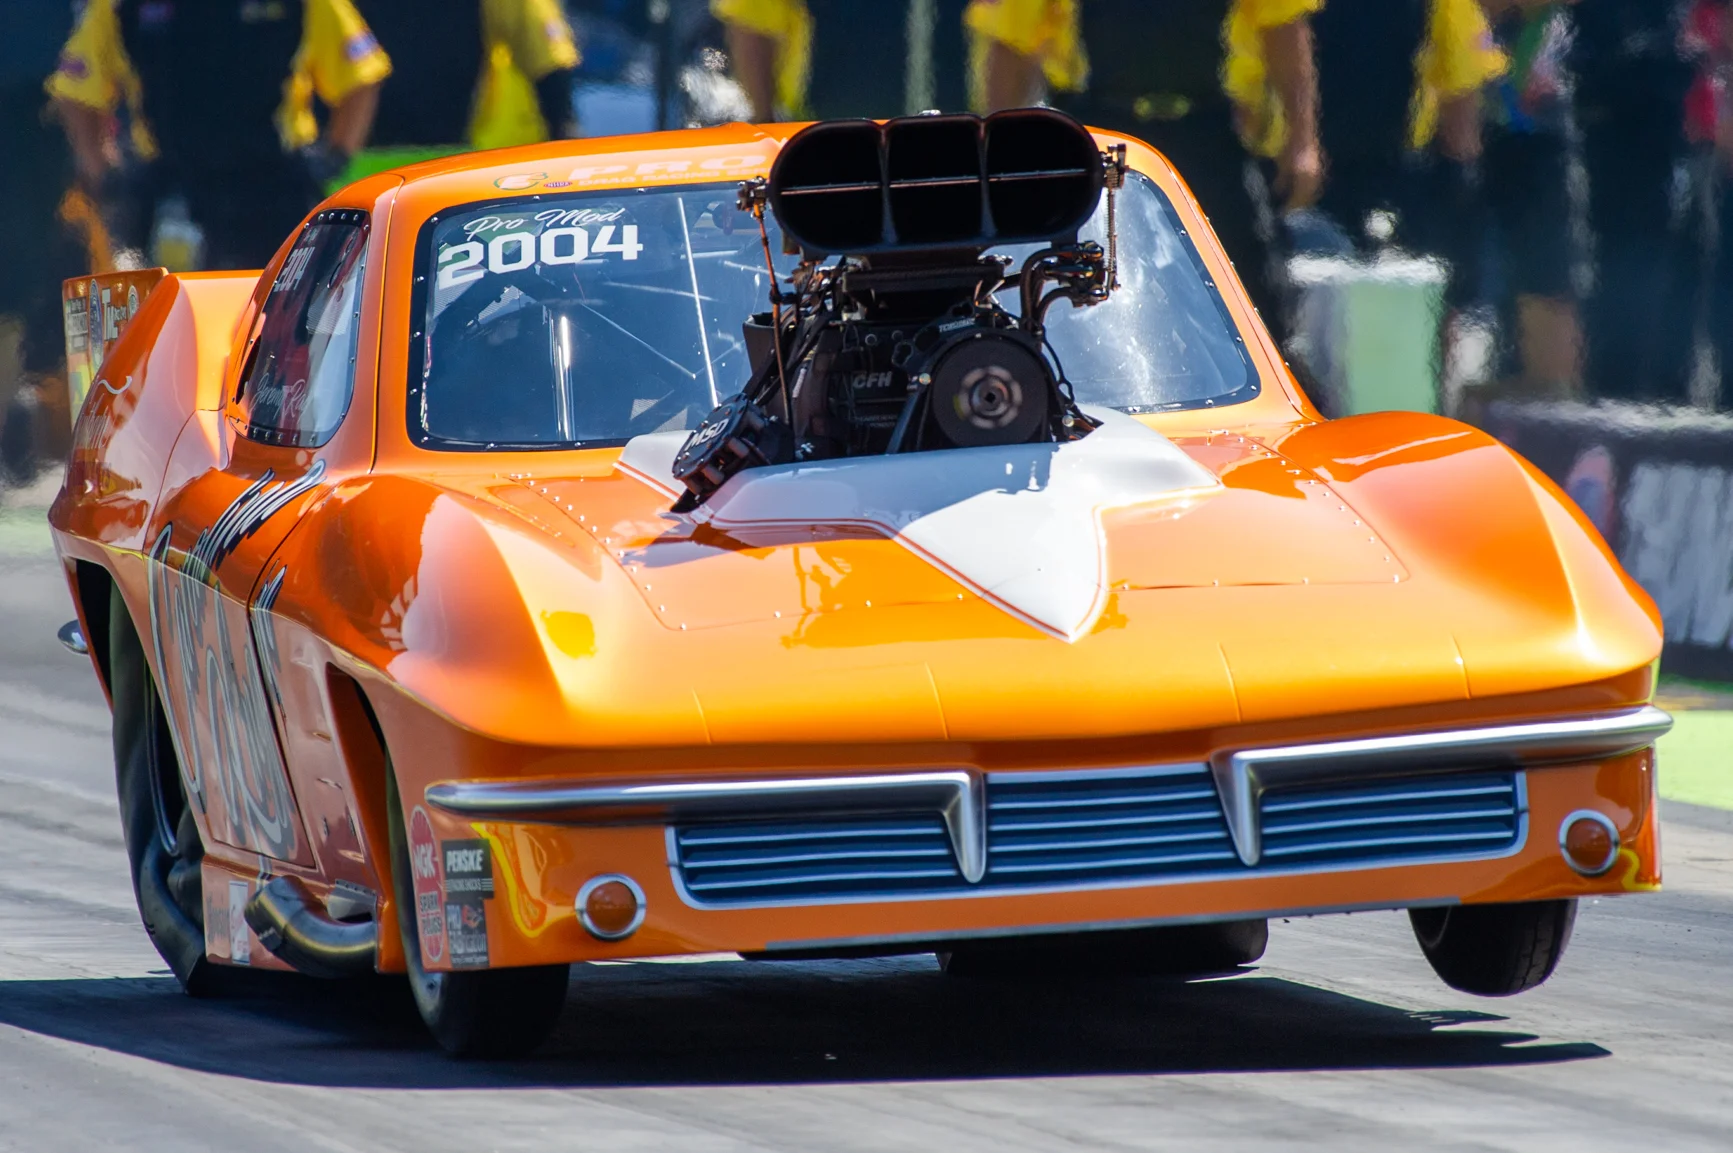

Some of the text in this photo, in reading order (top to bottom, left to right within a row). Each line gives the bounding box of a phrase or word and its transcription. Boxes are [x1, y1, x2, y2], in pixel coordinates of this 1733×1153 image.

[568, 155, 767, 181] PRO
[578, 176, 636, 188] DRAG
[641, 170, 719, 183] RACING
[463, 208, 626, 242] Pro Mod
[273, 247, 316, 293] 2004
[438, 225, 644, 290] 2004
[684, 418, 729, 451] MSD
[413, 843, 436, 879] NGK
[446, 849, 484, 872] PENSKE
